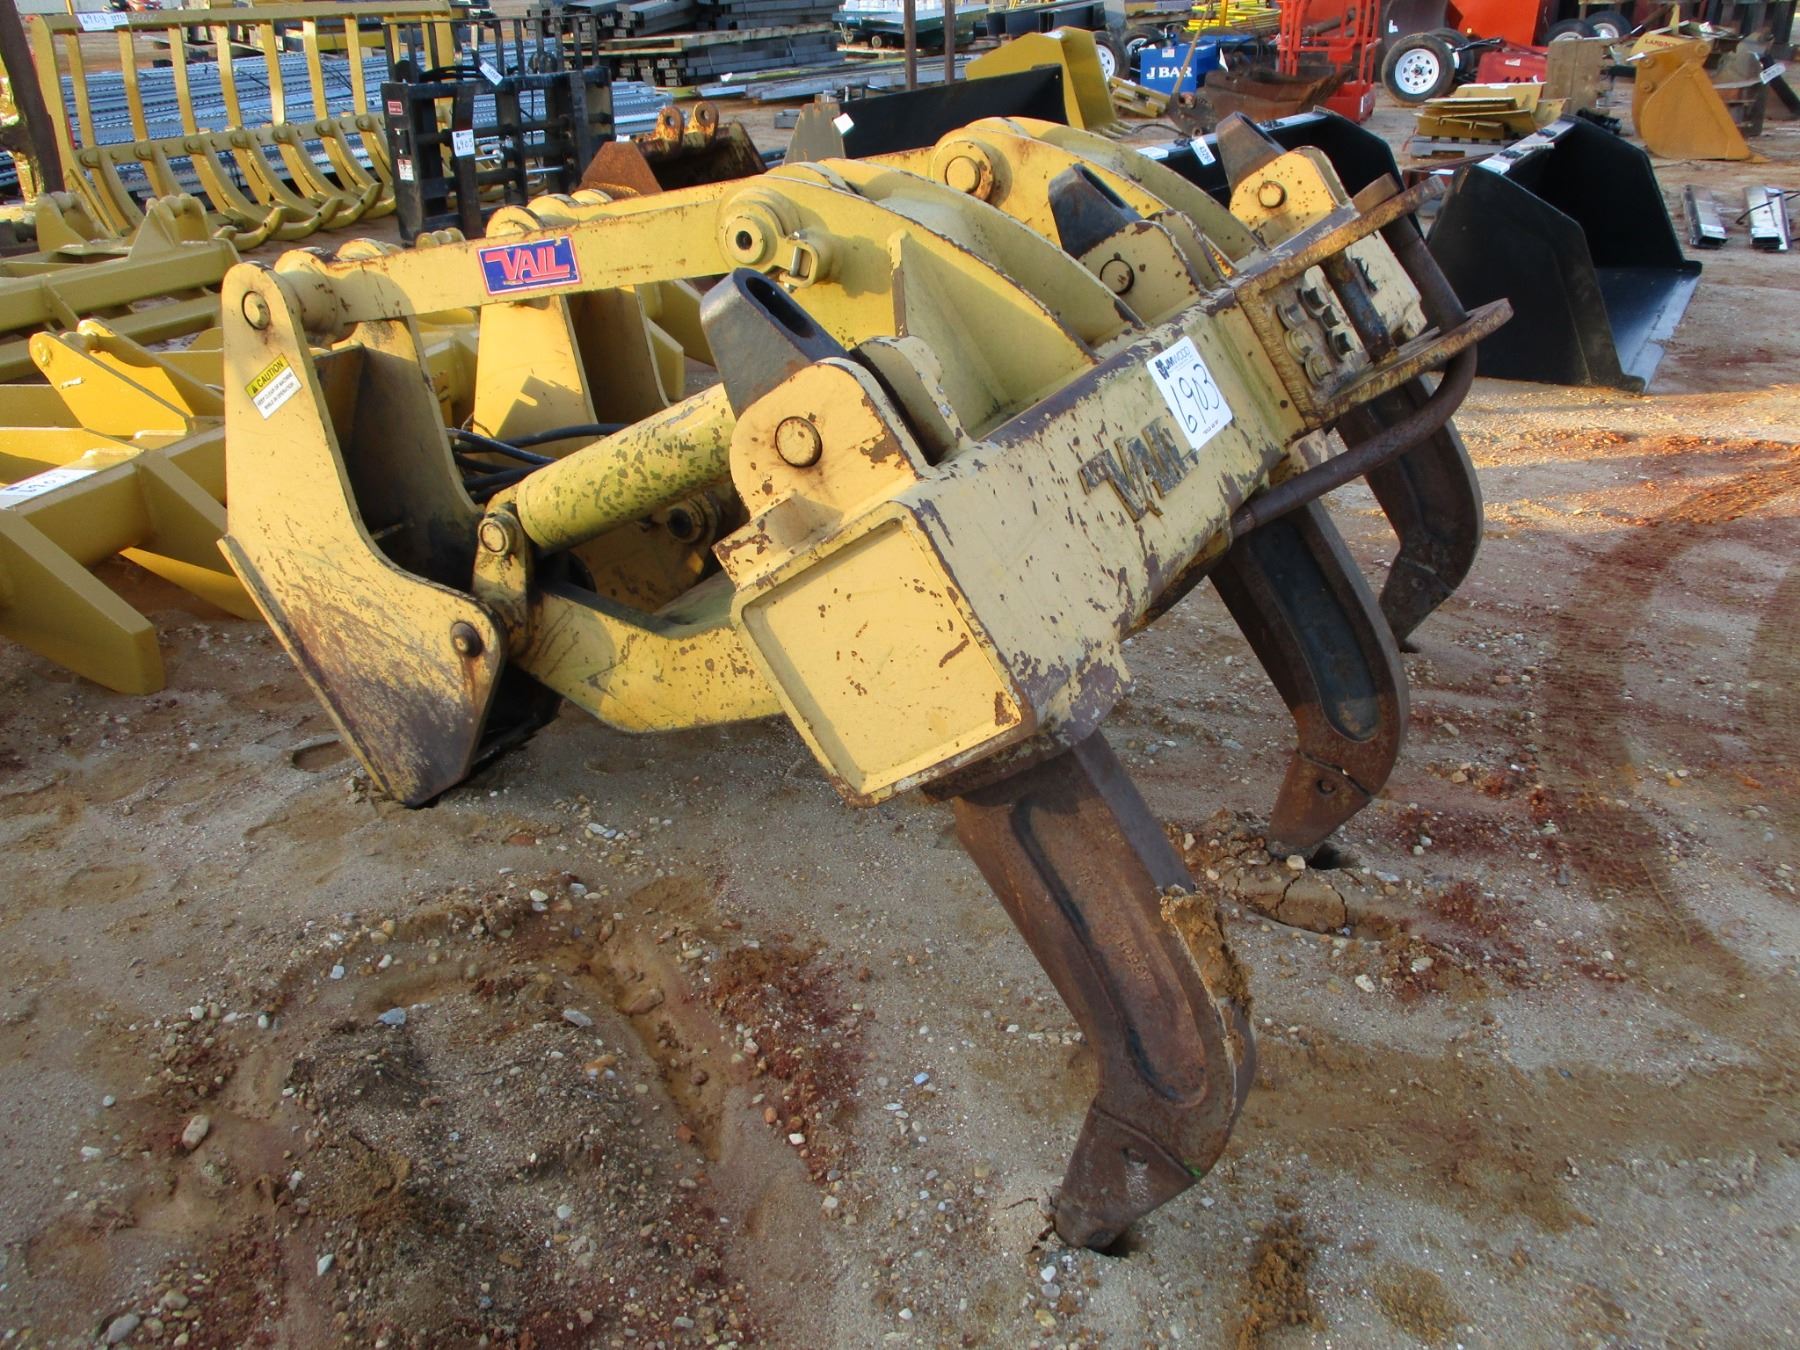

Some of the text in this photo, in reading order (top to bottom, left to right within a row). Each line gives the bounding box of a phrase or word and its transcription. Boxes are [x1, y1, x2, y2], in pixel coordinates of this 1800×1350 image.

[1146, 66, 1192, 79] J BAR
[485, 246, 570, 284] VAIL
[256, 360, 284, 388] CAUTION
[1169, 363, 1220, 434] 6903
